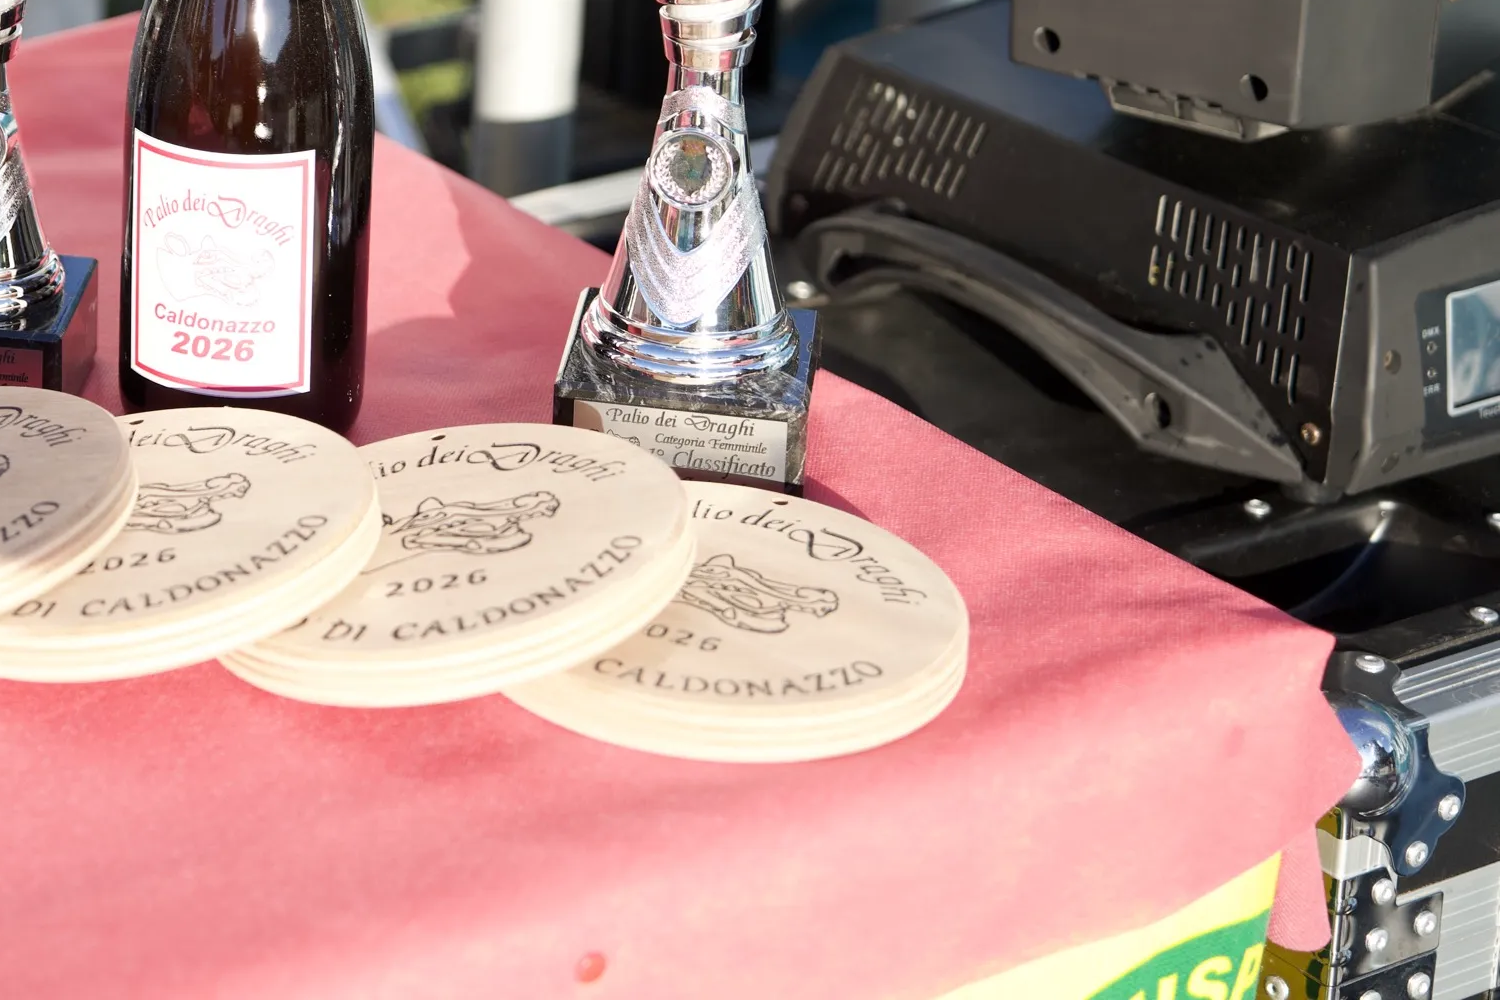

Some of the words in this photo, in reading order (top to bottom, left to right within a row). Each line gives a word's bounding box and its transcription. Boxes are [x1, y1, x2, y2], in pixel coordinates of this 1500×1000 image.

[143, 194, 179, 229] Palio
[182, 188, 206, 212] dei
[206, 195, 296, 247] Draghi
[153, 302, 276, 334] Caldonazzo
[170, 330, 256, 362] 2026
[605, 407, 650, 428] Palio
[654, 409, 678, 429] dei
[684, 414, 755, 441] Draghi
[163, 426, 318, 465] Draghi
[655, 432, 706, 450] Categoria
[708, 438, 768, 455] Femminile
[368, 459, 407, 480] lio
[417, 443, 470, 468] dei
[467, 441, 627, 484] Draghi
[672, 450, 776, 480] Classificato
[10, 600, 58, 619] DI
[79, 512, 329, 619] CALDONAZZO
[692, 498, 733, 521] lio
[740, 499, 800, 534] dei
[791, 526, 928, 607] Draghi
[322, 618, 368, 642] DI
[392, 533, 643, 643] CALDONAZZO
[386, 569, 489, 598] 2026
[646, 623, 723, 653] 026
[593, 657, 883, 698] CALDONAZZO
